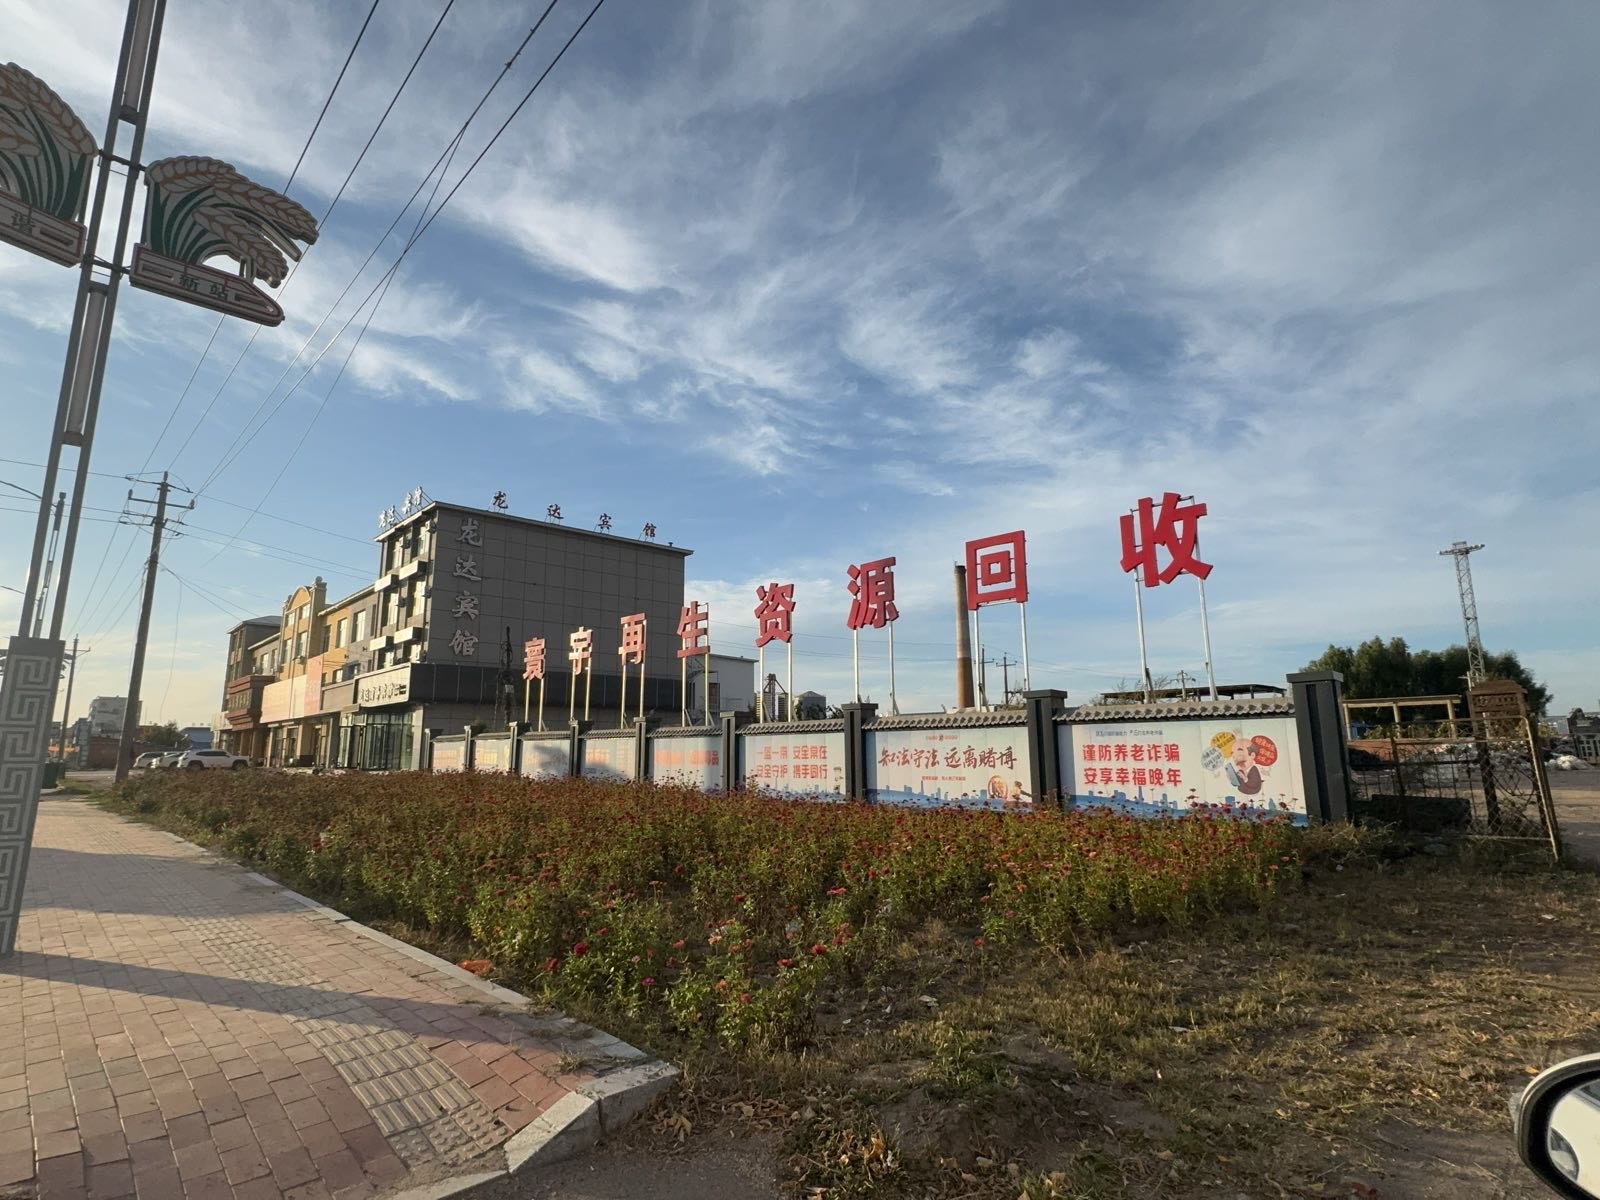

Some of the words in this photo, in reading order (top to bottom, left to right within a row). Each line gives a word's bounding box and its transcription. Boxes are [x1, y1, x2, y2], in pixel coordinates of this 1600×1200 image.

[180, 274, 230, 301] 新站
[492, 490, 658, 538] 龙达宾馆
[448, 517, 483, 657] 龙达宾馆
[522, 491, 1214, 680] 寰宇再生资源回收
[878, 746, 940, 769] 知法守法
[943, 745, 1018, 770] 远离赌博
[1082, 743, 1181, 762] 谨防养老诈骗
[792, 763, 828, 780] 携手同行
[1083, 767, 1183, 787] 安享幸福晚年
